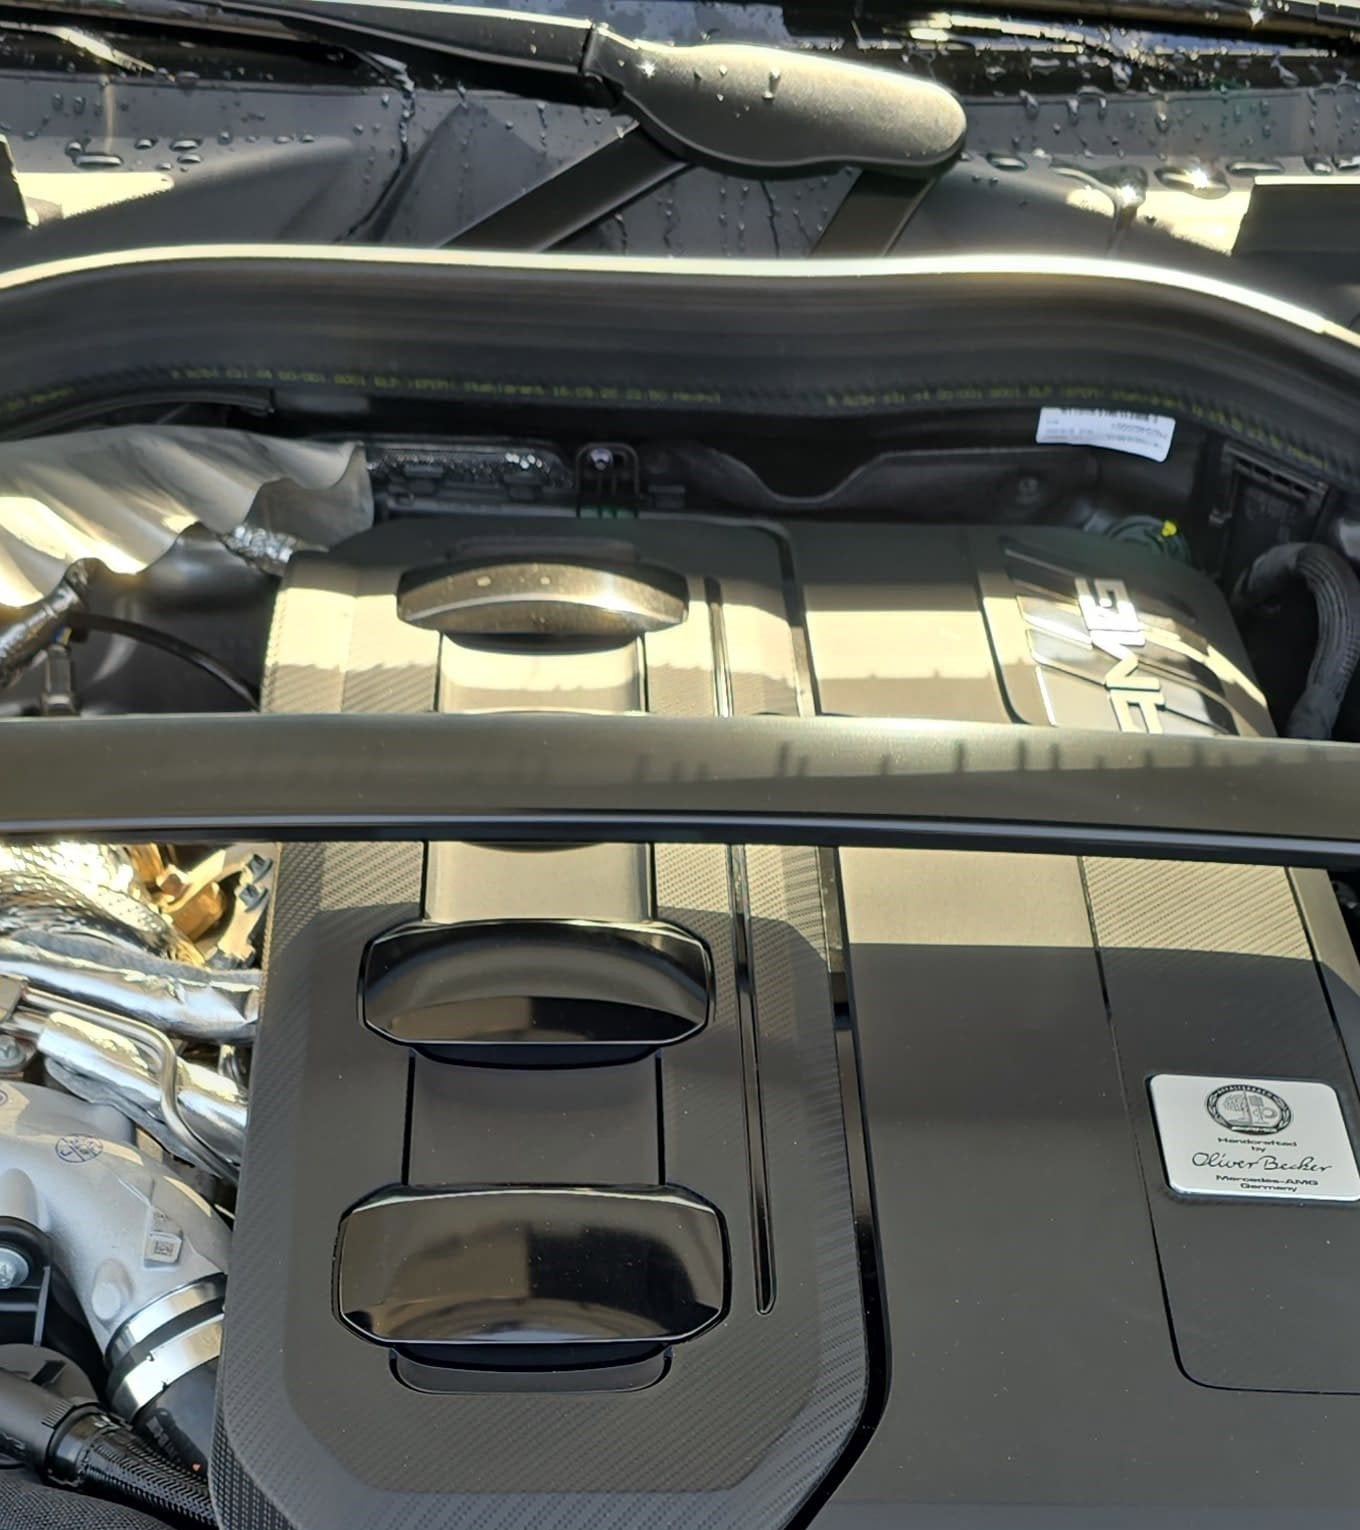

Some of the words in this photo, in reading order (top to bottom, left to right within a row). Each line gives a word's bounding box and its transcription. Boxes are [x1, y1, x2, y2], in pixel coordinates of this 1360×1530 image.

[1074, 578, 1166, 735] AMG
[1217, 1137, 1297, 1147] Handcrafted
[1251, 1145, 1266, 1153] by
[1192, 1152, 1260, 1169] Oliver
[1258, 1155, 1333, 1171] Becker
[1216, 1175, 1319, 1186] Mercedes-AMG
[1240, 1182, 1298, 1192] Germany
